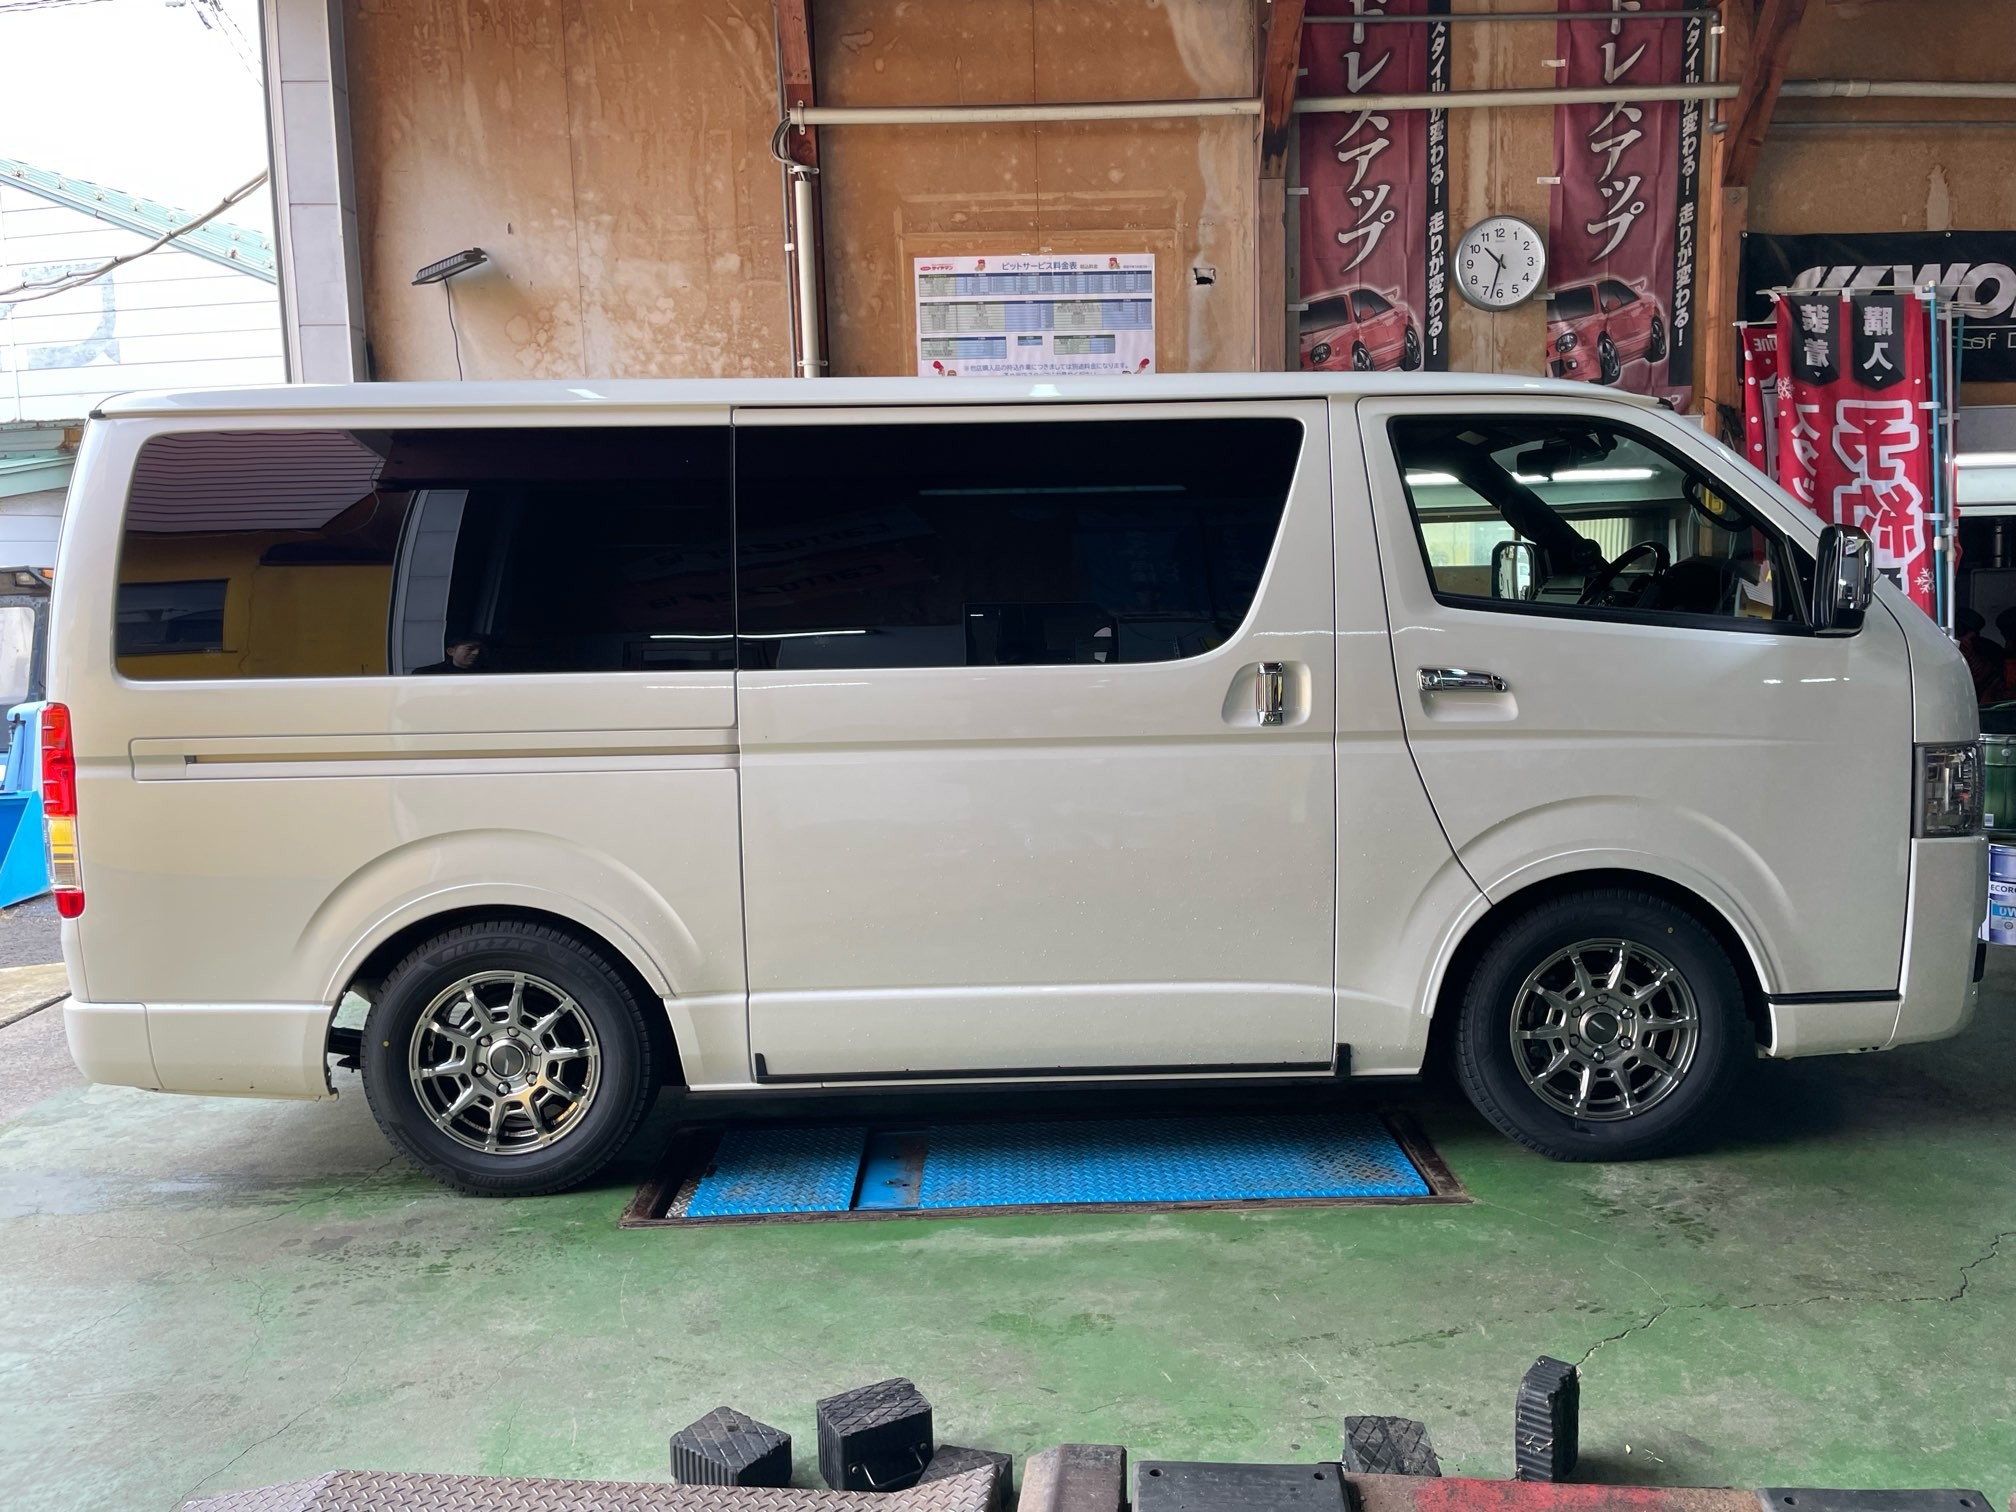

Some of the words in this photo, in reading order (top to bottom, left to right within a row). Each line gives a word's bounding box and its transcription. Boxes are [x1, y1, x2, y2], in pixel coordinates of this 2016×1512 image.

[1335, 0, 1396, 273] ドレスアップ
[1587, 0, 1646, 263] ドレスアップ
[1481, 233, 1490, 242] 11
[1494, 228, 1505, 238] 12
[1513, 231, 1518, 240] 1
[1470, 244, 1481, 254] 10
[1523, 241, 1530, 251] 2
[1466, 259, 1474, 269] 9
[1527, 256, 1534, 266] 3
[1470, 275, 1478, 285] 8
[1522, 273, 1530, 282] 4
[1482, 285, 1490, 295] 7
[1496, 288, 1504, 298] 6
[1511, 284, 1519, 294] 5
[1990, 885, 2016, 893] ECOR
